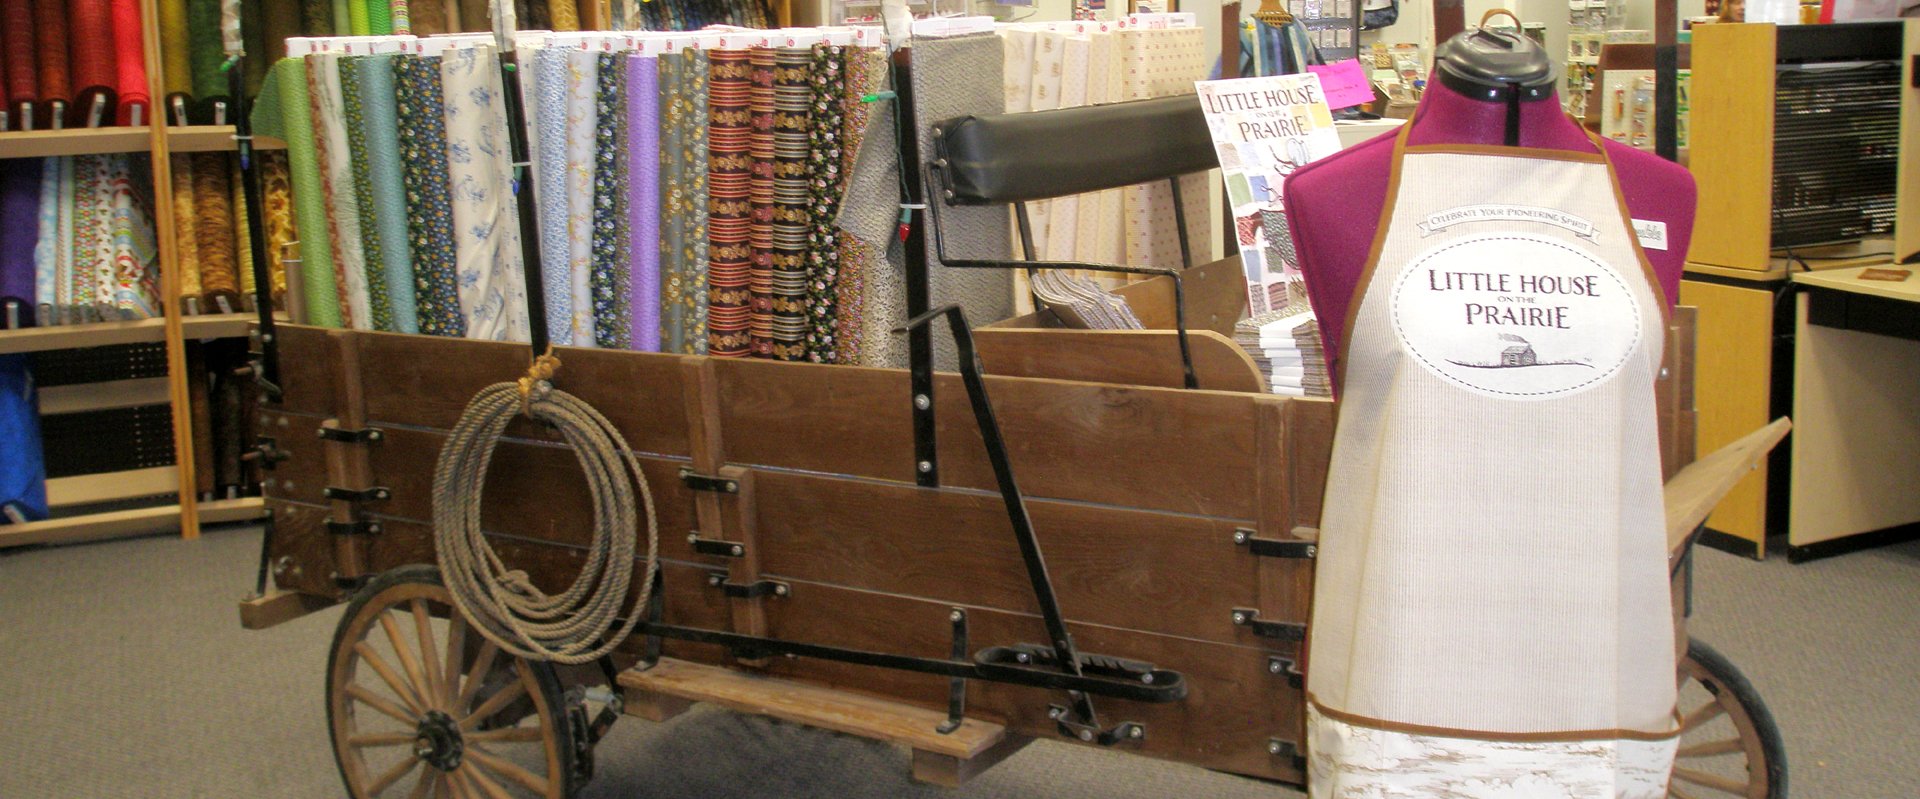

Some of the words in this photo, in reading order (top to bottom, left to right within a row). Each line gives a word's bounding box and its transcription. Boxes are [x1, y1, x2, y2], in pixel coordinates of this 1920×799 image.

[1206, 91, 1262, 114] LITTLE
[1264, 84, 1318, 107] HOUSE
[1238, 115, 1309, 142] PRAIRIE
[1430, 208, 1478, 225] CELEBRATE
[1479, 208, 1504, 217] YOUR
[1507, 208, 1559, 222] PIONEERING
[1560, 215, 1589, 231] SPIRIT
[1428, 269, 1512, 293] LITTLE
[1520, 274, 1601, 297] HOUSE
[1465, 303, 1571, 330] PRAIRIE
